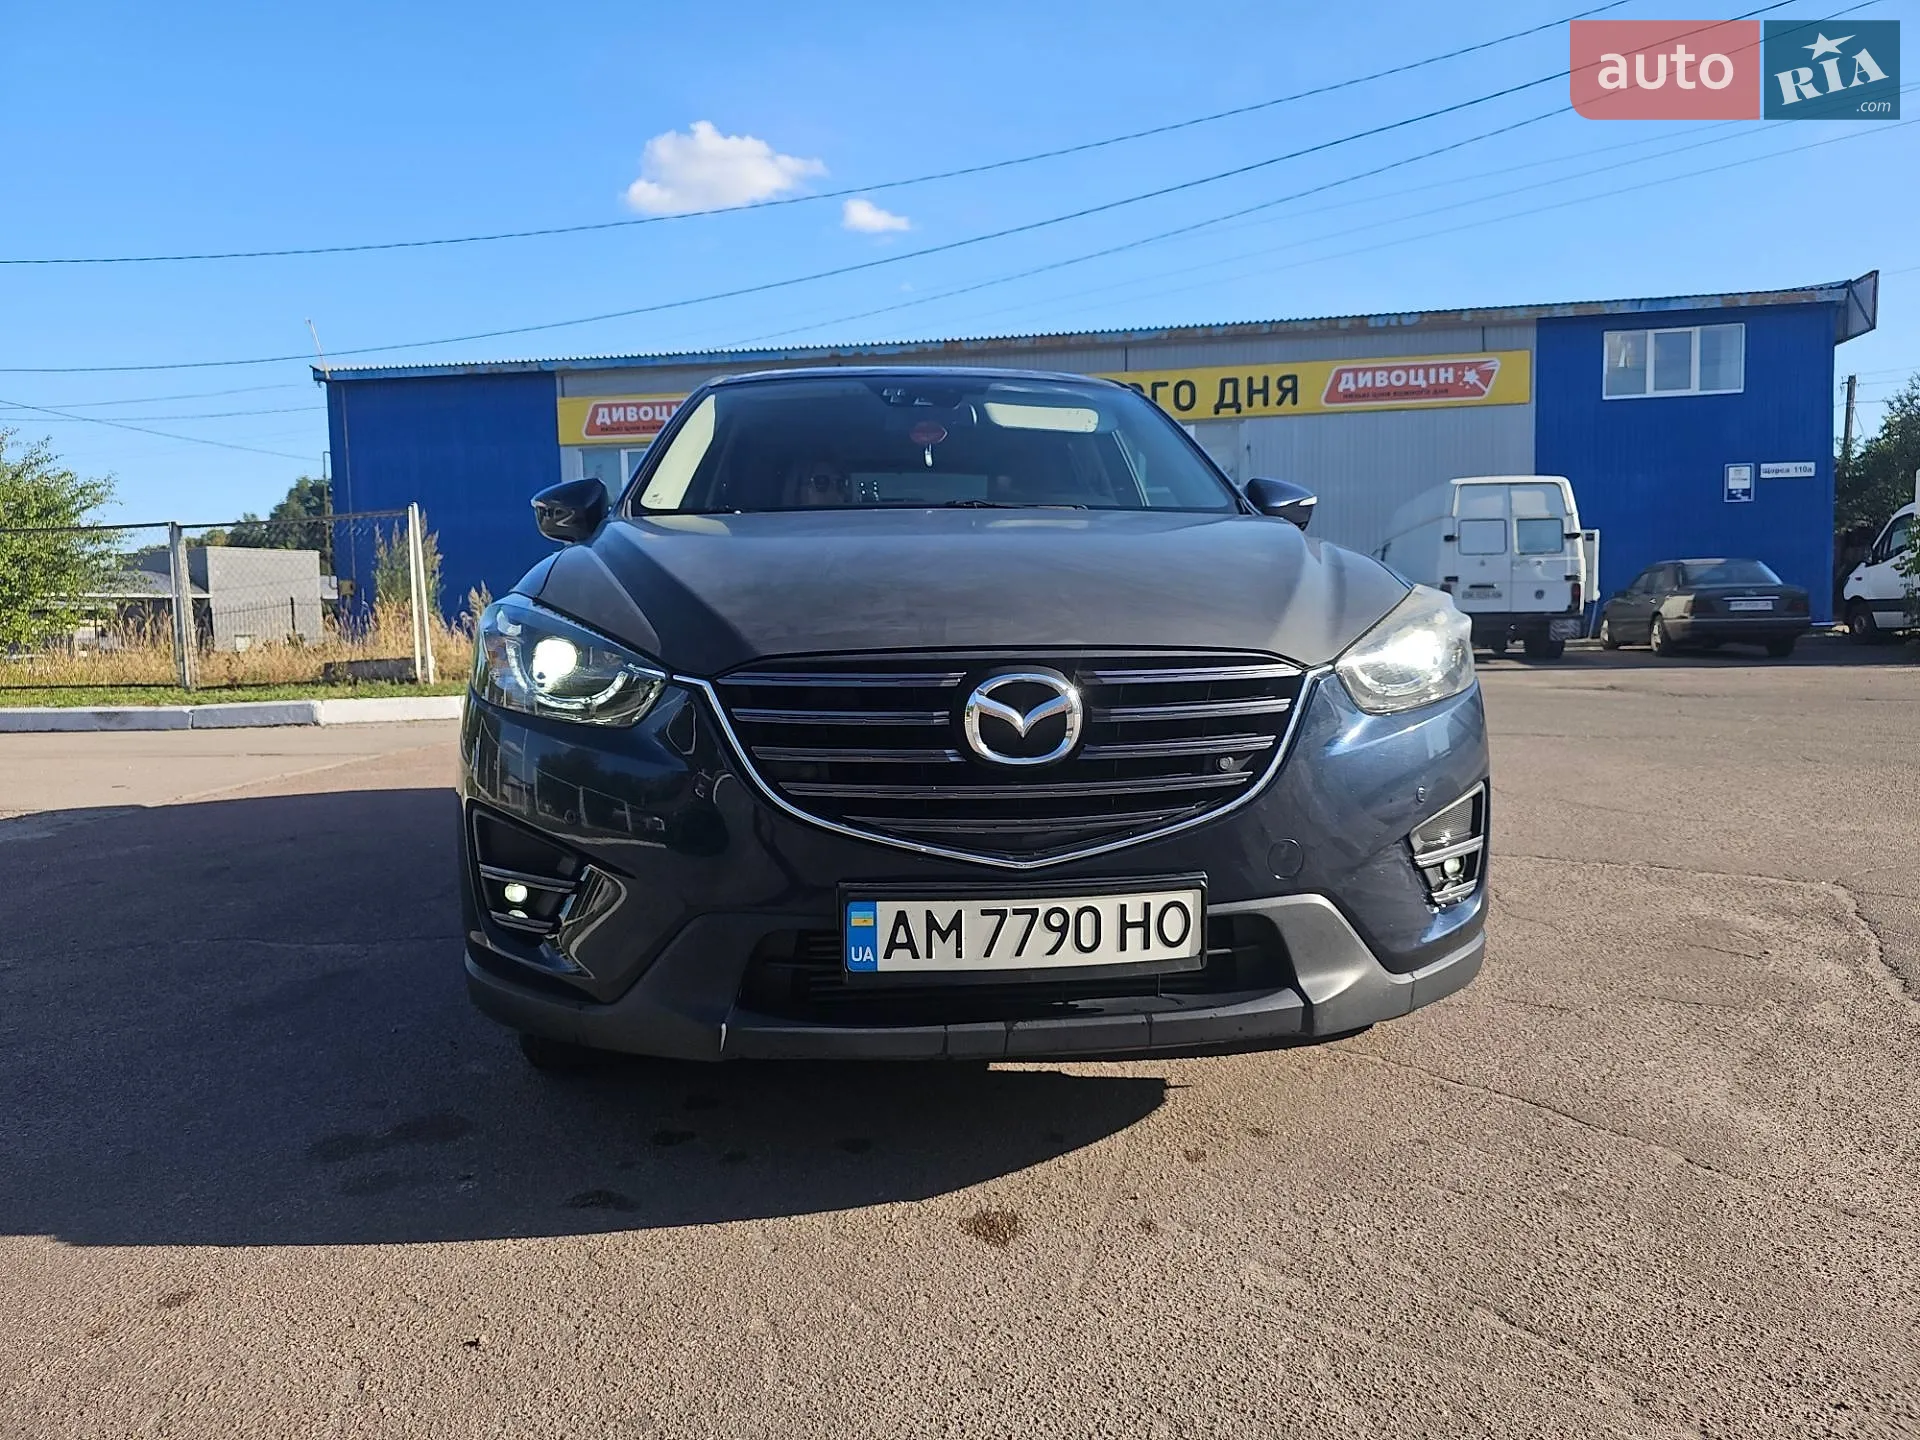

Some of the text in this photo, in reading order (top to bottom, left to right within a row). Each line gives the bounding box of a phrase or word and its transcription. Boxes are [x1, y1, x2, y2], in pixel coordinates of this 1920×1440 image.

[1213, 374, 1299, 415] ДНЯ
[1338, 366, 1455, 392] ДИВОЦІН
[851, 900, 1192, 962] UA AM 7790 HO
